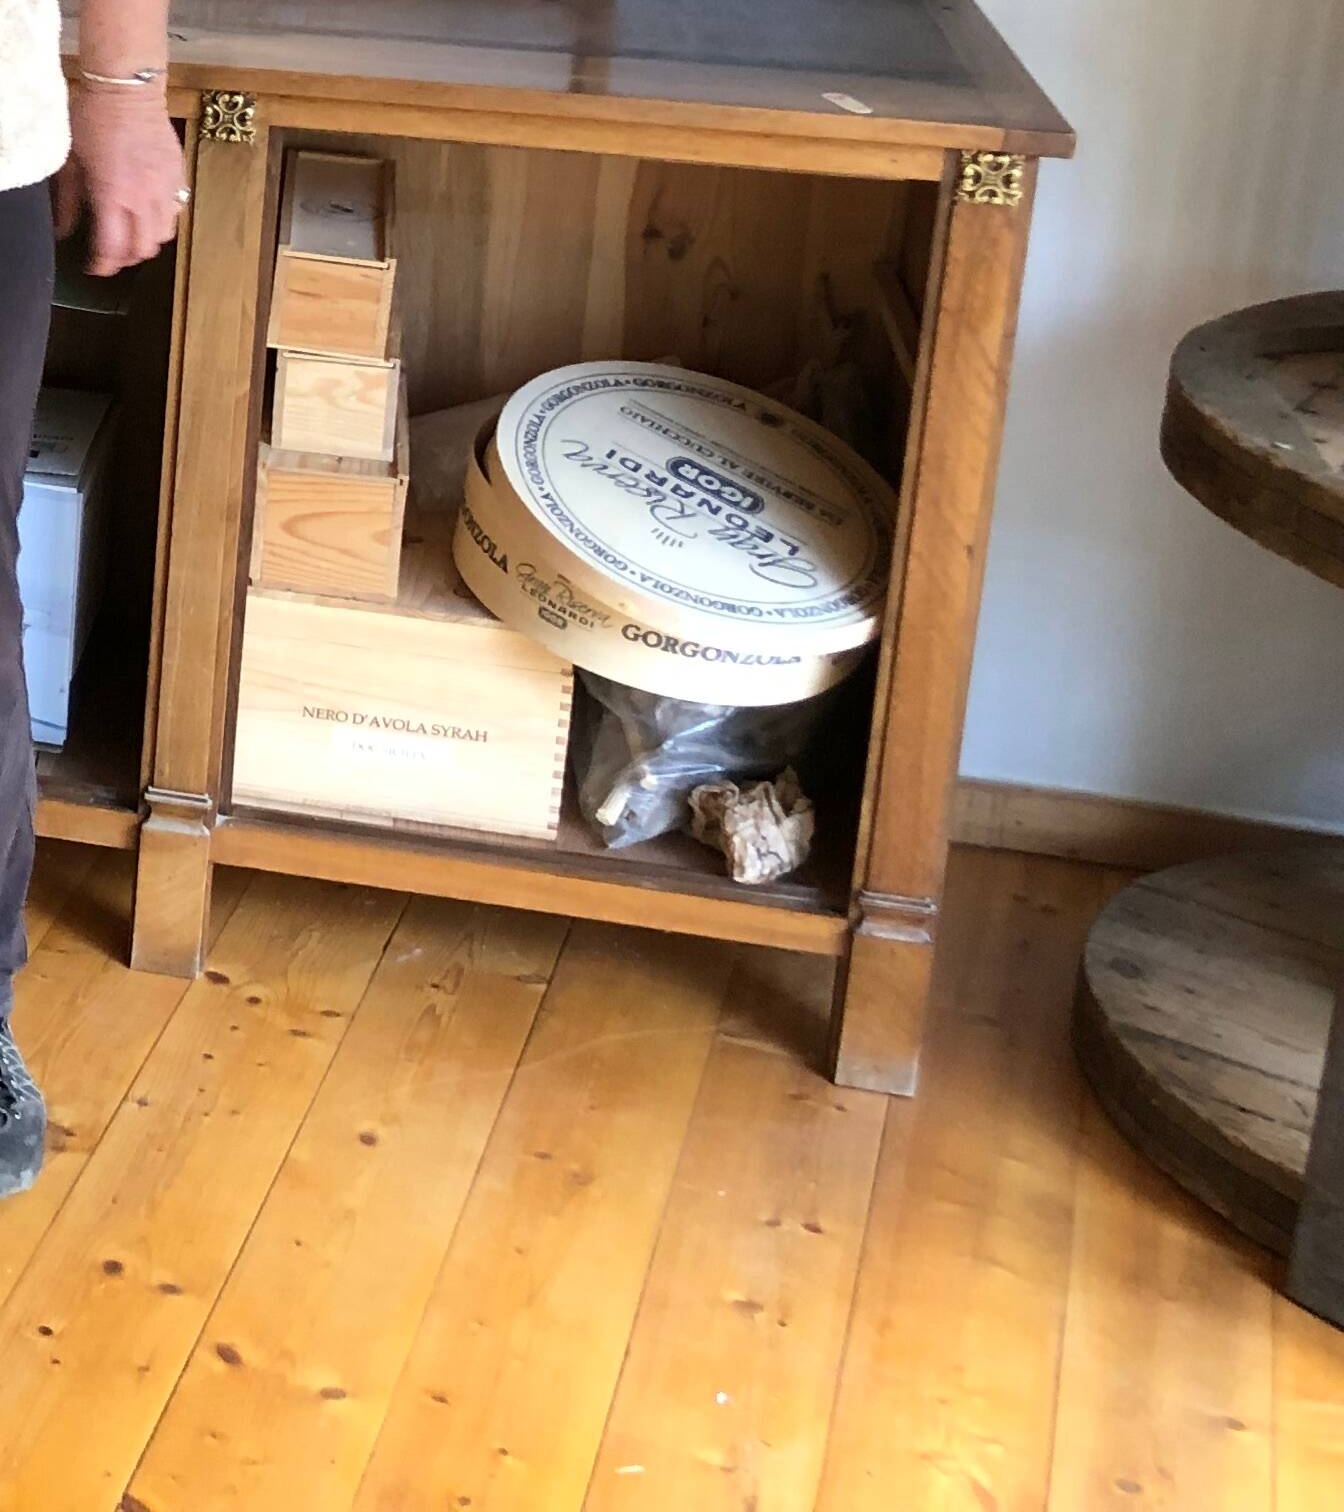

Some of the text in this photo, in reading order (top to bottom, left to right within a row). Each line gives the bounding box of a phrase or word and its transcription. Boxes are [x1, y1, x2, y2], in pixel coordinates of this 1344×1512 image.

[523, 414, 546, 485] GORGONZOLA
[606, 449, 800, 557] LEONARDI
[677, 463, 758, 511] IGOR
[541, 491, 628, 572] GORGONZOLA
[521, 584, 595, 629] LEONARDI
[640, 573, 763, 617] GORGONZOLA
[301, 705, 488, 743] NERO D'AVOLA SYRAH
